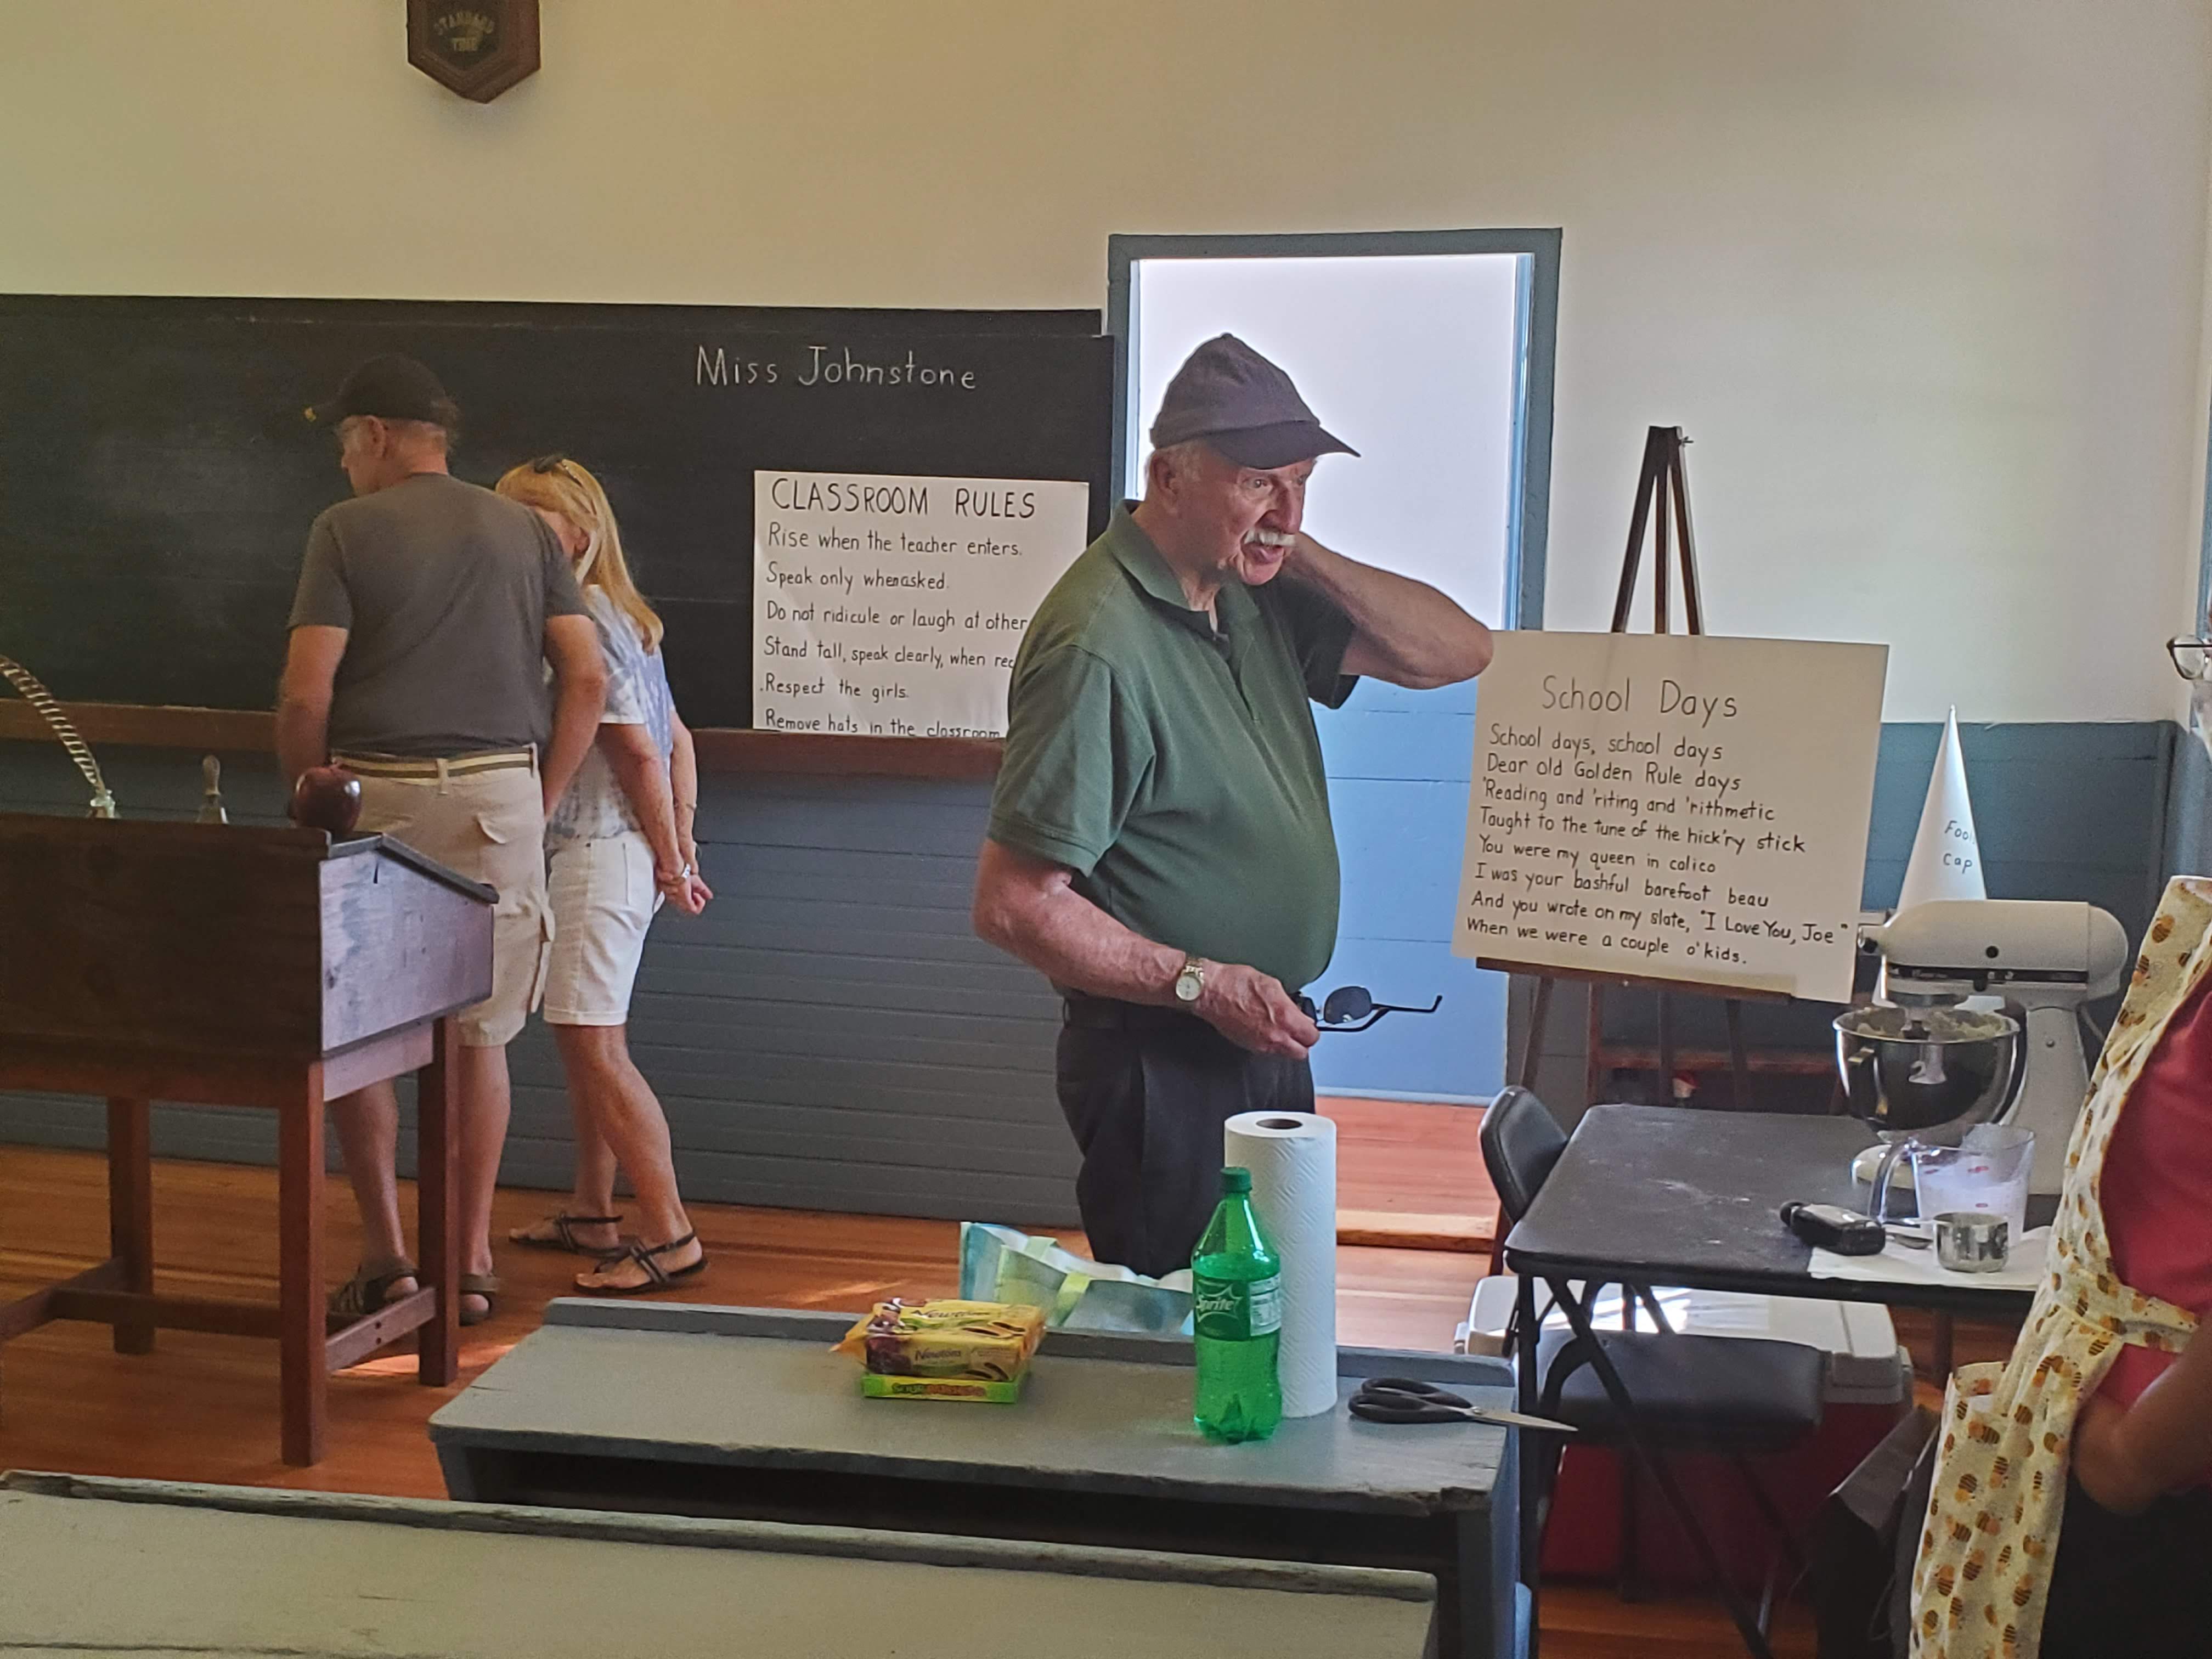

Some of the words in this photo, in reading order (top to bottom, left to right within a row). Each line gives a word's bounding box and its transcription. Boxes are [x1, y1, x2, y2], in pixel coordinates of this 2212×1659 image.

[697, 345, 778, 385] Miss
[799, 346, 975, 388] Johnstone
[771, 477, 928, 515] CLASSROOM
[955, 488, 1035, 518] RULES
[768, 522, 809, 547] Rise
[819, 526, 859, 550] when
[867, 529, 892, 551] the
[900, 532, 957, 553] teacher
[967, 538, 1022, 556] enters.
[766, 561, 812, 589] Speak
[820, 566, 853, 595] only
[768, 600, 786, 620] Do
[792, 602, 814, 622] not
[823, 605, 880, 624] ridicule
[890, 614, 905, 625] or
[913, 608, 955, 632] laugh
[964, 610, 980, 629] at
[764, 635, 807, 657] Stand
[817, 639, 847, 663] tall,
[851, 644, 889, 665] speak
[895, 645, 943, 670] clearly,
[950, 647, 985, 666] when
[839, 678, 861, 696] the
[1542, 675, 1630, 712] School
[1660, 679, 1737, 729] Days
[765, 708, 821, 731] Remove
[828, 713, 858, 733] hats
[870, 721, 882, 734] in
[890, 718, 916, 737] the
[1489, 723, 1541, 748] School
[1551, 731, 1595, 759] days,
[1607, 731, 1660, 755] school
[1674, 736, 1723, 768] days
[1487, 752, 1528, 773] Dear
[1536, 757, 1562, 776] old
[1574, 761, 1632, 781] Golden
[1645, 761, 1683, 785] Rule
[1695, 770, 1741, 799] days
[1556, 788, 1584, 805] and
[1646, 797, 1675, 814] and
[1480, 806, 1531, 835] Taught
[1538, 812, 1555, 831] to
[1562, 815, 1588, 833] the
[1593, 819, 1626, 837] tune
[1631, 820, 1648, 837] of
[1655, 823, 1680, 842] the
[1686, 827, 1745, 855] hick'ry
[1757, 831, 1806, 853] stick
[1479, 834, 1503, 854] You
[1513, 844, 1551, 857] were
[1556, 849, 1579, 868] my
[1590, 852, 1635, 870] queen
[1646, 853, 1660, 869] in
[1669, 854, 1716, 873] calico
[1943, 853, 1973, 874] Cap
[1475, 862, 1487, 878] I
[1491, 869, 1517, 882] was
[1525, 872, 1564, 892] your
[1573, 868, 1629, 893] bashful
[1645, 878, 1711, 901] barefoot
[1728, 886, 1769, 907] beau
[1467, 917, 1508, 935] When
[1517, 926, 1539, 939] we
[1545, 930, 1588, 946] were
[1601, 934, 1612, 947] a
[1620, 936, 1669, 957] couple
[1471, 890, 1504, 909] And
[1513, 899, 1538, 921] you
[1547, 899, 1588, 917] wrote
[1595, 907, 1614, 920] on
[1620, 910, 1642, 930] my
[1650, 909, 1690, 933] slate,
[1725, 916, 1760, 936] Love
[1763, 919, 1797, 945] You,
[1196, 1293, 1234, 1312] Sprite
